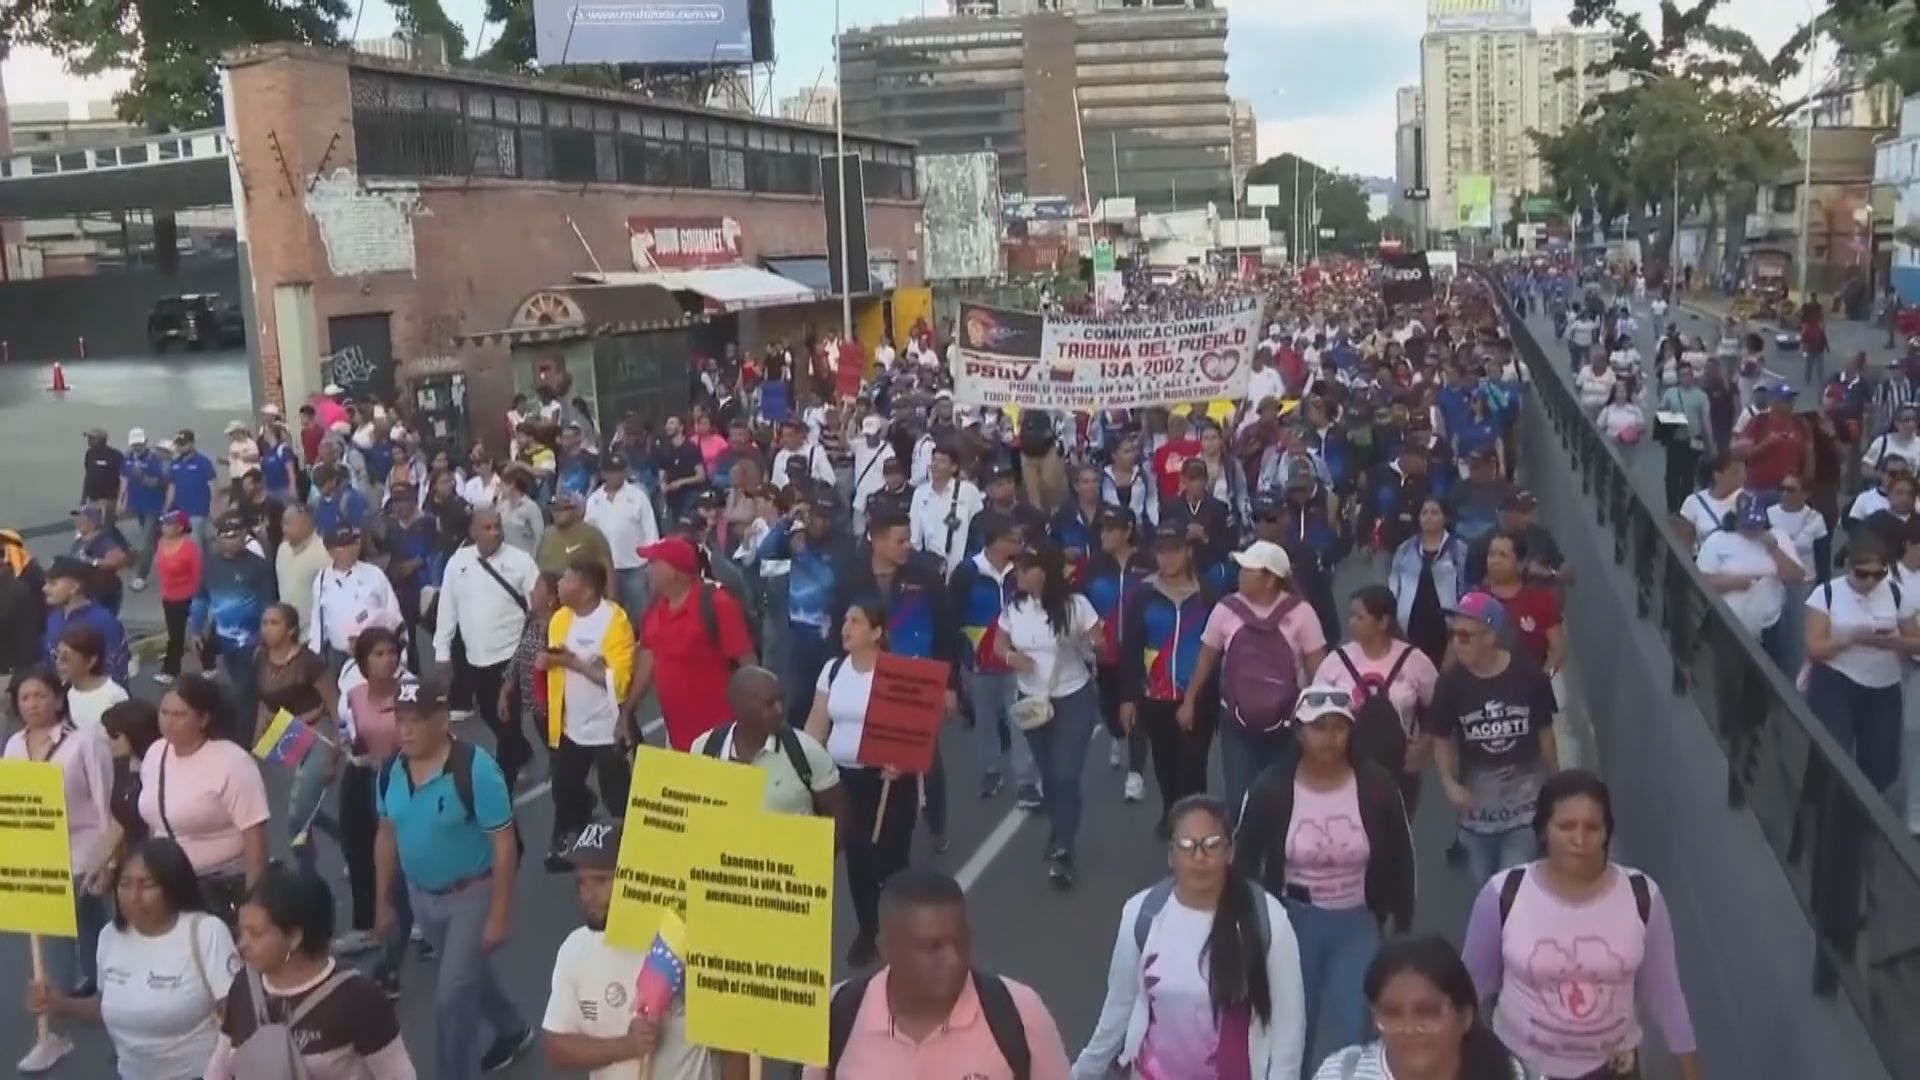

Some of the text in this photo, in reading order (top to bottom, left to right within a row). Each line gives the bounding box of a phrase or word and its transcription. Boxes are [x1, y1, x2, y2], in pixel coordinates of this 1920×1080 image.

[1083, 321, 1217, 340] COMUNICACIONAL
[1057, 328, 1247, 360] TRIBUNA DEL PUEBLO
[1464, 718, 1529, 739] LACOSTE
[616, 866, 635, 881] Let's
[720, 852, 764, 872] Ganemos
[766, 859, 776, 873] la
[690, 866, 748, 887] defendamos
[749, 875, 760, 890] la
[785, 880, 813, 897] Basta
[814, 884, 827, 900] de
[705, 889, 753, 907] amenazas
[754, 895, 811, 915] criminales!
[686, 947, 706, 968] Let's
[707, 954, 723, 970] win
[755, 960, 775, 980] let's
[776, 964, 809, 985] defend
[697, 972, 816, 1009] Enough of criminal threats!
